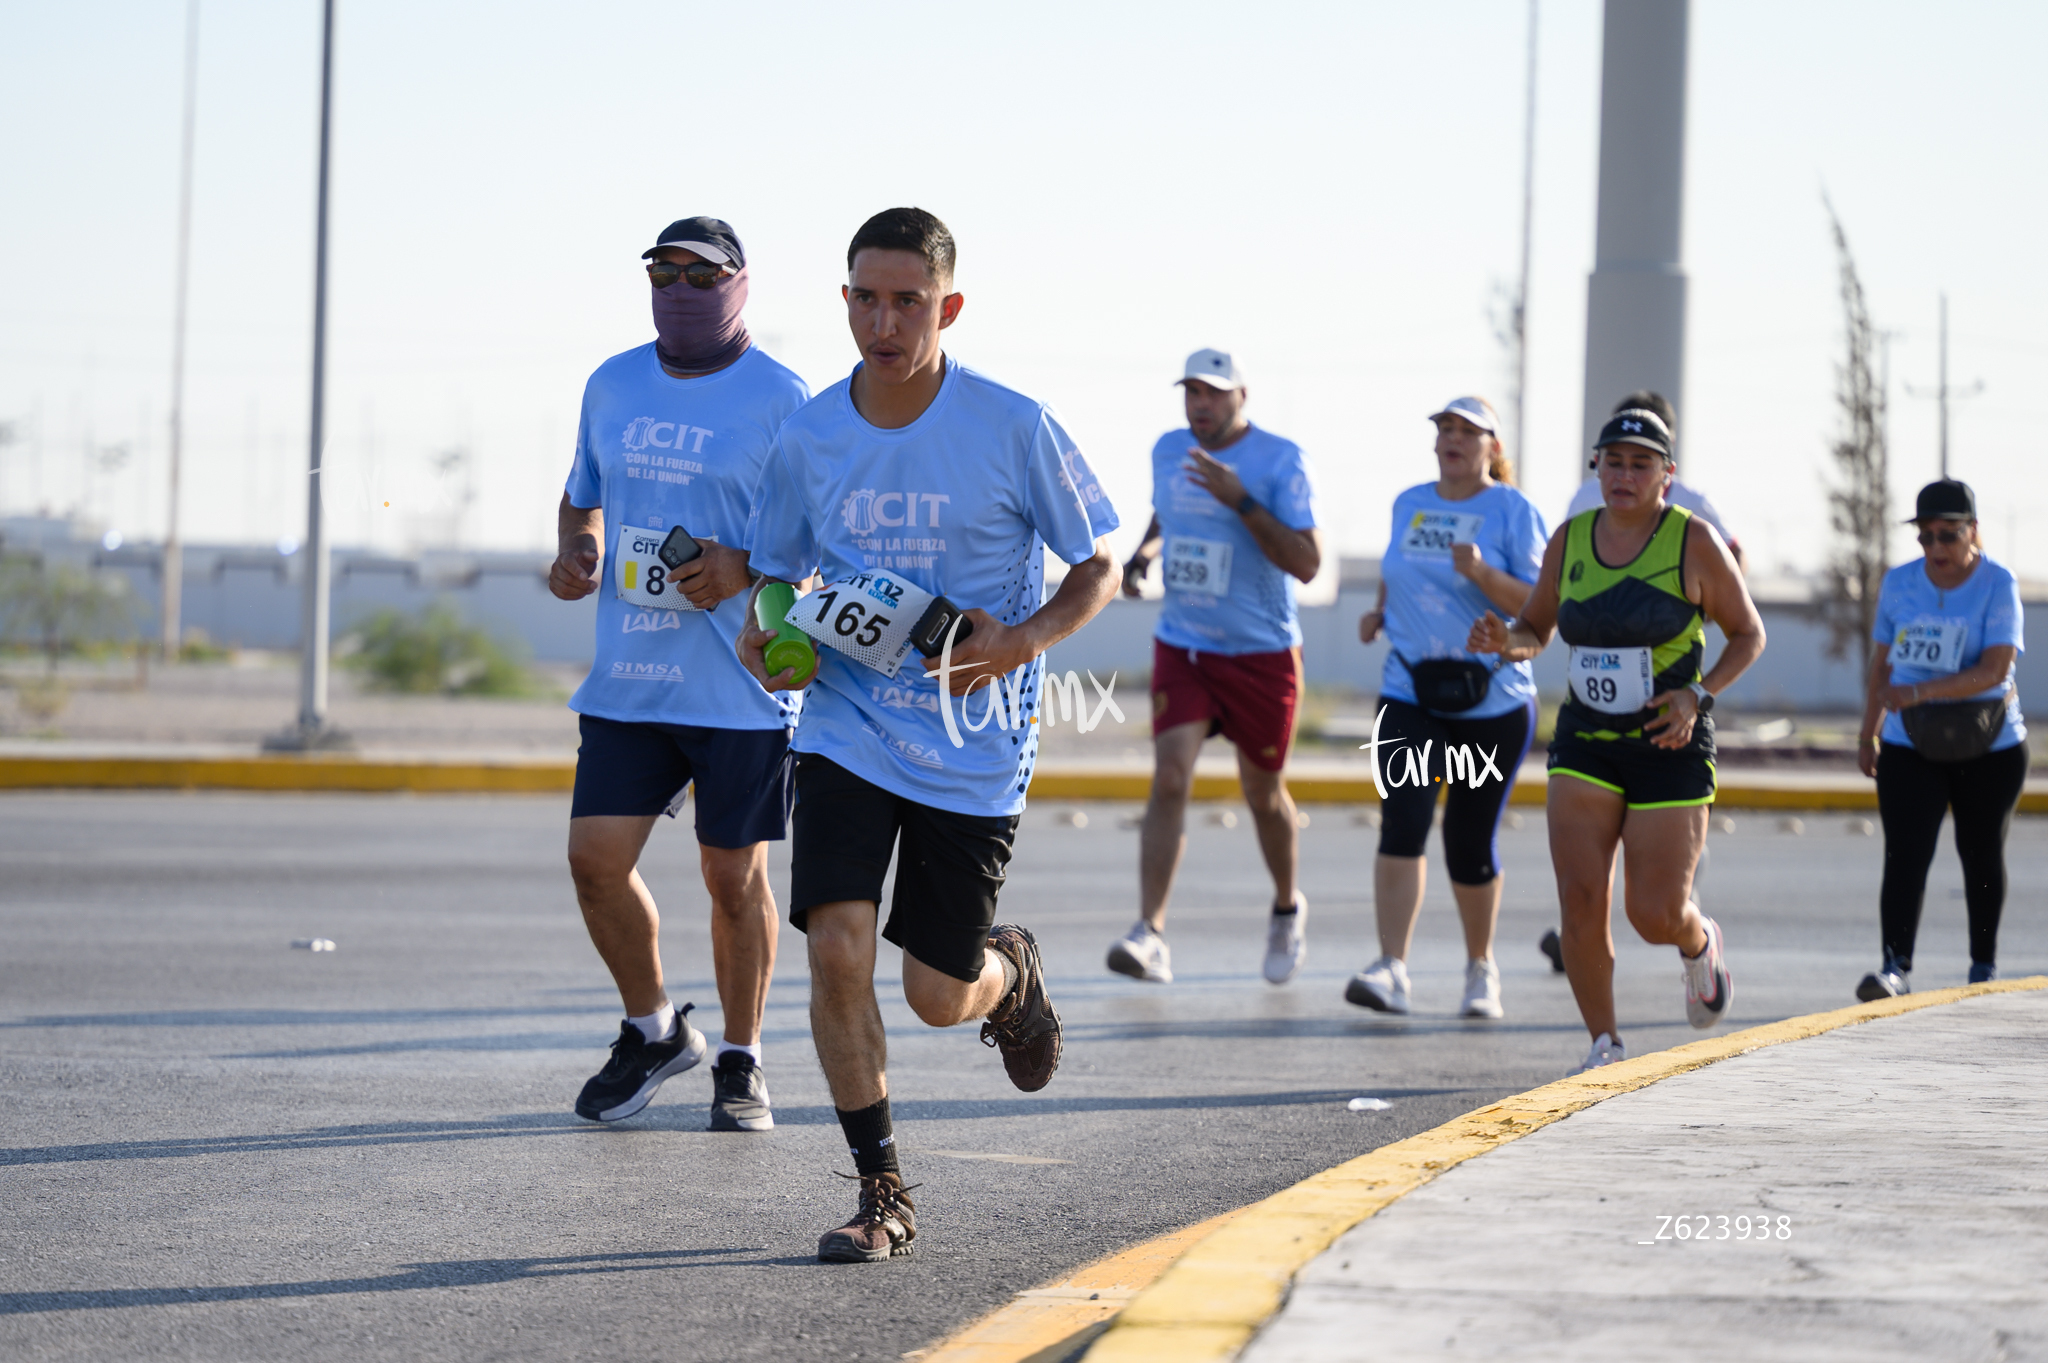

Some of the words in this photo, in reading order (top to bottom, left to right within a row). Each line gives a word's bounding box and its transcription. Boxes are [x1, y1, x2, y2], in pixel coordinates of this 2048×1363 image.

[647, 422, 714, 454] CIT
[627, 467, 641, 479] DE
[643, 468, 656, 480] LA
[651, 455, 664, 467] LA
[666, 457, 703, 475] FUERZA
[873, 491, 951, 528] CIT
[632, 541, 660, 555] CIT
[885, 538, 902, 551] LA
[904, 538, 947, 552] FUERZA
[1409, 528, 1455, 550] 200
[877, 556, 893, 569] LA
[1168, 559, 1209, 585] 259
[622, 611, 681, 634] LALA
[815, 590, 891, 647] 165
[1897, 640, 1941, 663] 370
[612, 661, 684, 676] SIMSA
[1586, 676, 1617, 704] 89
